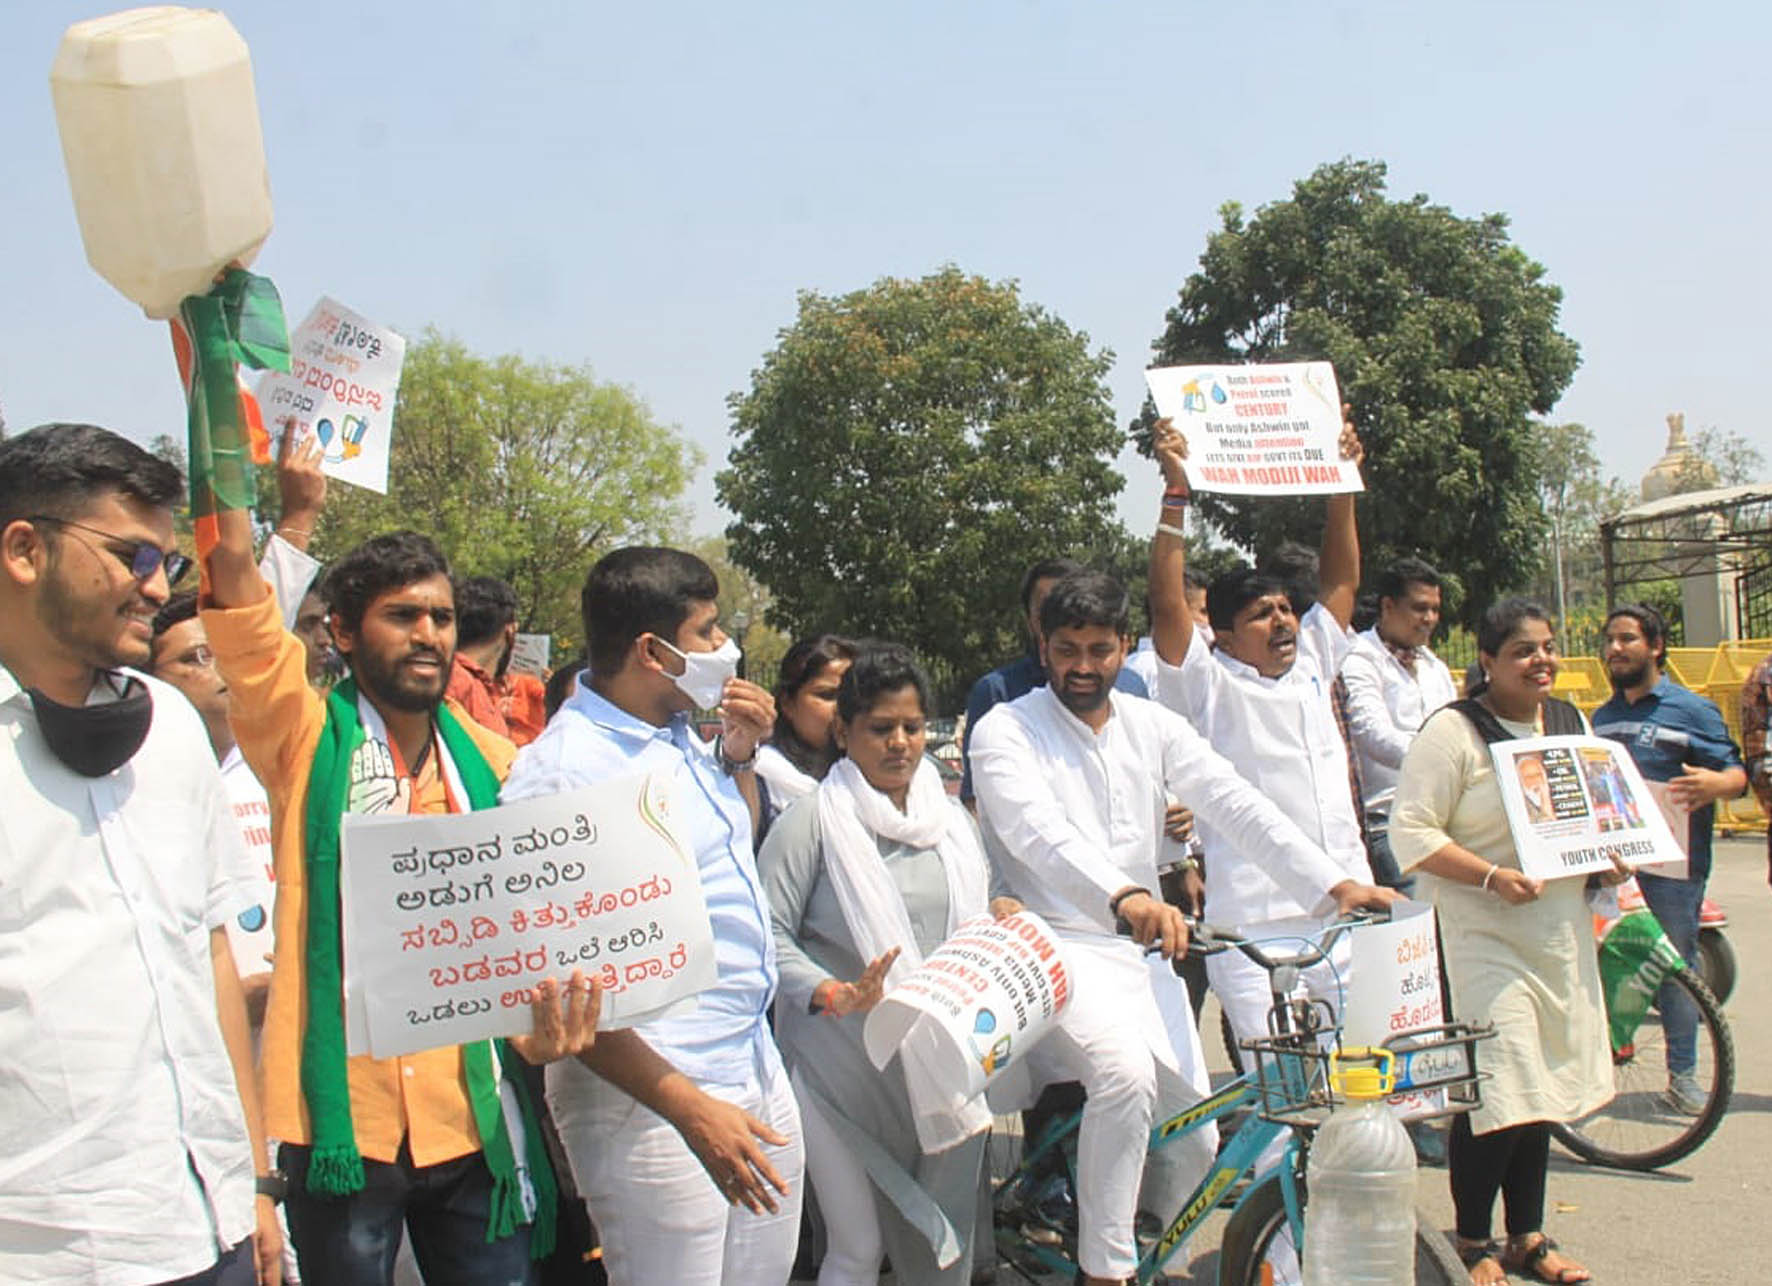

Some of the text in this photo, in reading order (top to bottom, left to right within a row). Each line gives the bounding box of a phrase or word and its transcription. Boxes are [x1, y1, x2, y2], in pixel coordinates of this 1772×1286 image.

[1234, 402, 1289, 417] CENTURY
[1259, 387, 1293, 399] scored
[1205, 421, 1224, 433] But
[1225, 422, 1248, 435] only
[1249, 421, 1291, 433] Ashwin
[1218, 437, 1252, 449] Media
[1303, 447, 1324, 461] DUE
[1199, 465, 1343, 485] WAH MODIJI WAH
[391, 813, 598, 878] ಪ್ರಧಾನ ಮಂತ್ರಿ
[1560, 840, 1656, 868] YOUTH CONGRESS
[396, 860, 586, 911] ಅಡುಗೆ ಅನಿಲ
[402, 873, 673, 951] ಸಬ್ಸಿಡಿ ಕಿತ್ತುಕೊಂಡು
[429, 921, 665, 988] ಬಡವರ ಒಲೆ ಆರಿಸಿ
[995, 916, 1056, 962] MOD
[918, 959, 989, 993] CENT
[990, 965, 1018, 1000] only
[1004, 955, 1038, 1006] Media
[406, 996, 492, 1026] ಒಡಲು
[930, 990, 962, 1018] Both
[1013, 999, 1028, 1032] But
[1164, 1195, 1207, 1246] YULU
